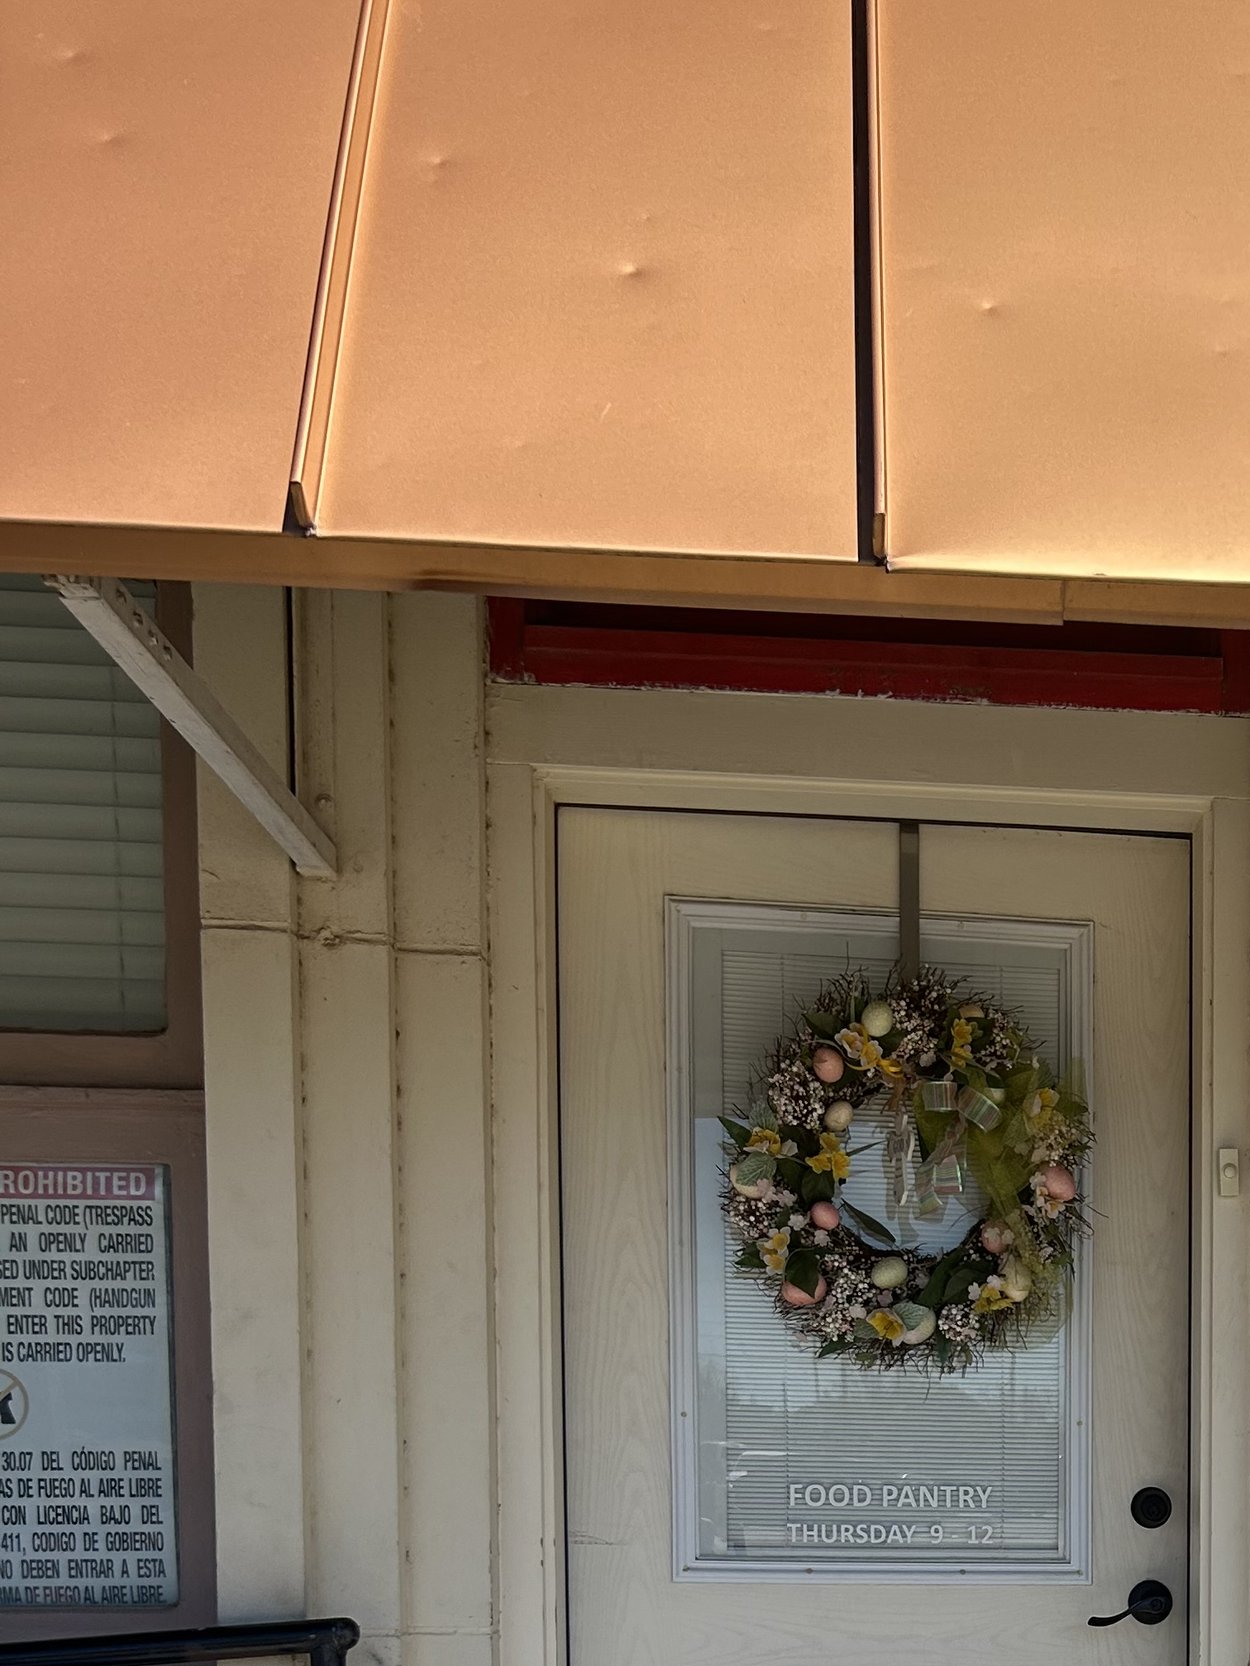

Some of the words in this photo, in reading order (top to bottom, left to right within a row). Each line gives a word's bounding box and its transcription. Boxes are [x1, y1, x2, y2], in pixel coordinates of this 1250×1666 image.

[1, 1204, 43, 1225] PENAL
[45, 1204, 80, 1226] CODE
[83, 1205, 153, 1230] (TRESPASS
[9, 1232, 28, 1252] AN
[39, 1232, 87, 1253] OPENLY
[98, 1233, 153, 1253] CARRIED
[23, 1260, 67, 1280] UNDER
[71, 1260, 155, 1281] SUBCHAPTER
[44, 1287, 79, 1308] CODE
[89, 1287, 156, 1313] (HANDGUN
[7, 1314, 48, 1335] ENTER
[54, 1315, 83, 1335] THIS
[91, 1315, 156, 1336] PROPERTY
[2, 1342, 14, 1362] IS
[17, 1342, 72, 1362] CARRIED
[76, 1342, 126, 1363] OPENLY.
[2, 1451, 33, 1471] 30.07
[41, 1451, 64, 1471] DEL
[72, 1446, 115, 1471] CÓDIGO
[124, 1451, 162, 1471] PENAL
[18, 1478, 33, 1498] DE
[38, 1478, 75, 1498] FUEGO
[80, 1478, 94, 1498] AL
[98, 1478, 125, 1498] AIRE
[129, 1478, 162, 1498] LIBRE
[788, 1484, 872, 1507] FOOD
[882, 1485, 993, 1508] PANTRY
[2, 1505, 26, 1525] CON
[37, 1505, 90, 1525] LICENCIA
[101, 1505, 131, 1525] BAJO
[141, 1505, 163, 1525] DEL
[32, 1532, 76, 1552] CODIGO
[83, 1532, 99, 1552] DE
[105, 1532, 164, 1552] GOBIERNO
[787, 1523, 916, 1545] THURSDAY
[930, 1525, 943, 1545] 9
[967, 1525, 993, 1544] 12
[21, 1559, 60, 1579] DEBEN
[68, 1559, 114, 1579] ENTRAR
[121, 1559, 130, 1578] A
[137, 1559, 166, 1579] ESTA
[25, 1586, 40, 1604] DE
[43, 1586, 81, 1604] FUEGO
[84, 1586, 99, 1604] AL
[101, 1586, 128, 1604] AIRE
